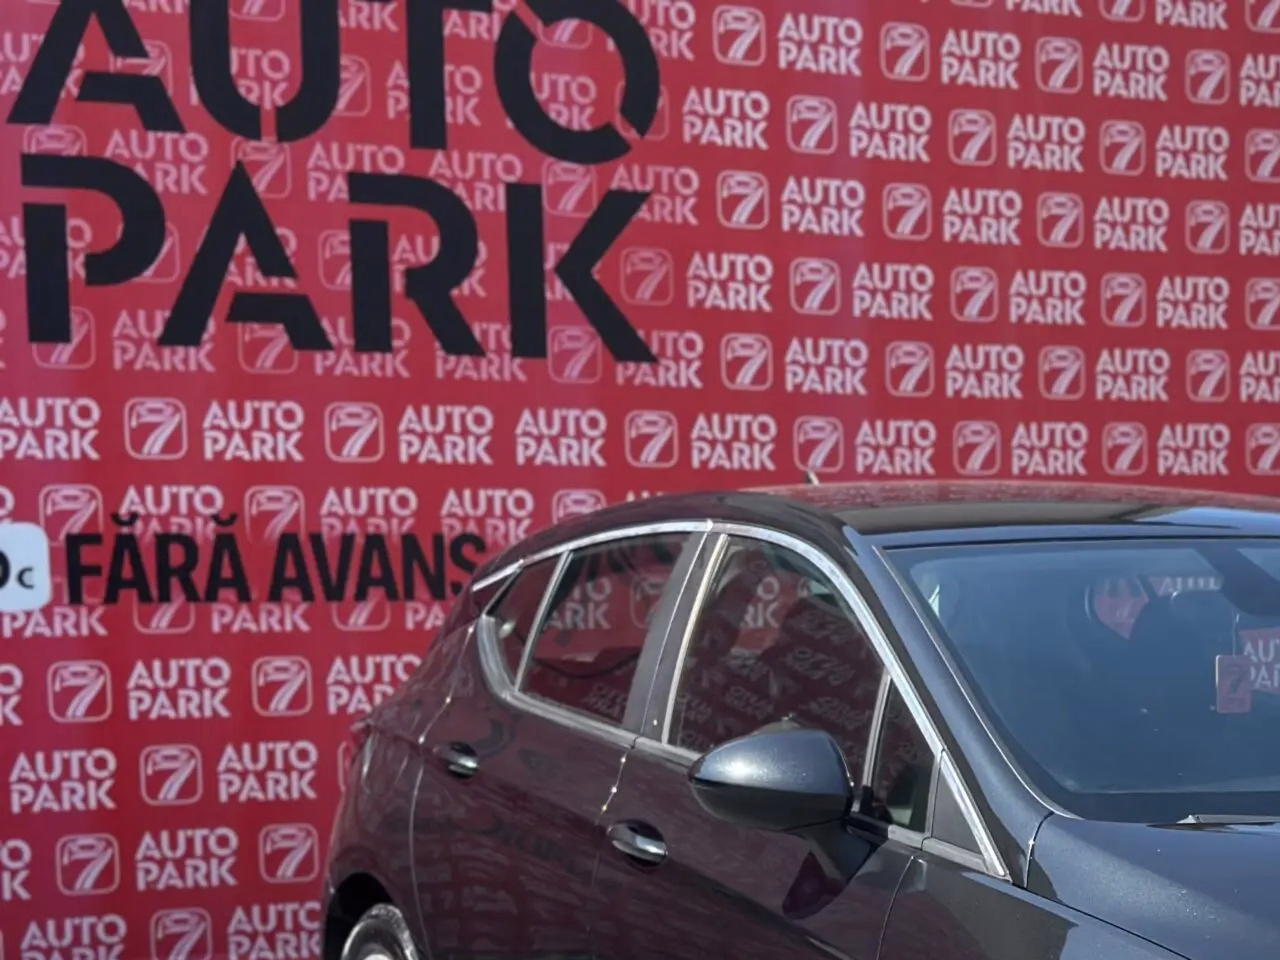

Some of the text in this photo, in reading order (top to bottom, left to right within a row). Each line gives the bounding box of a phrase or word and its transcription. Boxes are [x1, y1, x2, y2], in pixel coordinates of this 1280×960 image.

[777, 12, 864, 47] AUTO
[1155, 0, 1228, 30] PARK
[649, 27, 695, 61] RK
[778, 39, 862, 77] PARK
[940, 28, 1021, 61] AUTO
[1092, 42, 1170, 74] AUTO
[7, 0, 660, 166] AUTO
[531, 70, 597, 104] UTO
[941, 56, 1019, 90] PARK
[1093, 69, 1168, 102] PARK
[682, 86, 770, 121] AUTO
[848, 101, 932, 134] AUTO
[683, 114, 769, 150] PARK
[1006, 113, 1086, 145] AUTO
[1155, 125, 1230, 154] AUTO
[104, 129, 209, 162] AUTO
[307, 142, 405, 175] AUTO
[849, 128, 930, 163] PARK
[1007, 140, 1084, 173] PARK
[429, 149, 523, 183] AUTO
[610, 164, 700, 195] AUTO
[1155, 149, 1228, 181] PARK
[308, 171, 348, 202] PA
[781, 176, 866, 209] AUTO
[942, 187, 1023, 218] AUTO
[781, 203, 864, 237] PARK
[1093, 196, 1169, 226] AUTO
[943, 213, 1021, 246] PARK
[1094, 221, 1168, 252] PARK
[21, 153, 659, 363] PARK
[686, 252, 774, 284] AUTO
[852, 262, 935, 293] AUTO
[1008, 269, 1087, 297] AUTO
[1156, 276, 1230, 303] AUTO
[687, 279, 772, 312] PARK
[852, 288, 933, 321] PARK
[1009, 296, 1085, 325] PARK
[1156, 301, 1228, 330] PARK
[113, 341, 216, 372] PARK
[315, 348, 411, 377] PARK
[435, 352, 526, 381] PARK
[784, 337, 869, 368] AUTO
[945, 344, 1025, 372] AUTO
[1095, 348, 1171, 375] AUTO
[616, 359, 704, 388] PARK
[785, 363, 868, 396] PARK
[945, 370, 1023, 399] PARK
[1096, 373, 1168, 402] PARK
[202, 400, 304, 431] AUTO
[398, 405, 494, 434] AUTO
[515, 407, 607, 437] AUTO
[690, 413, 777, 442] AUTO
[203, 429, 304, 462] PARK
[399, 433, 493, 465] PARK
[855, 419, 937, 448] AUTO
[1011, 422, 1088, 449] AUTO
[1157, 423, 1230, 449] AUTO
[516, 436, 606, 467] PARK
[691, 440, 776, 471] PARK
[855, 445, 935, 475] PARK
[1011, 448, 1087, 476] PARK
[1157, 448, 1229, 476] PARK
[119, 484, 224, 517] AUTO
[320, 486, 418, 517] AUTO
[440, 488, 534, 518] AUTO
[65, 512, 486, 606] FĂRĂ AVANS
[3, 605, 107, 639] PARK
[212, 602, 310, 634] PARK
[406, 602, 446, 631] PA
[127, 657, 231, 689] AUTO
[129, 687, 230, 720] PARK
[9, 748, 116, 783] AUTO
[217, 740, 318, 773] AUTO
[10, 778, 115, 814] PARK
[218, 769, 317, 803] PARK
[135, 827, 238, 860] AUTO
[137, 856, 237, 891] PARK
[21, 914, 126, 950] AUTO
